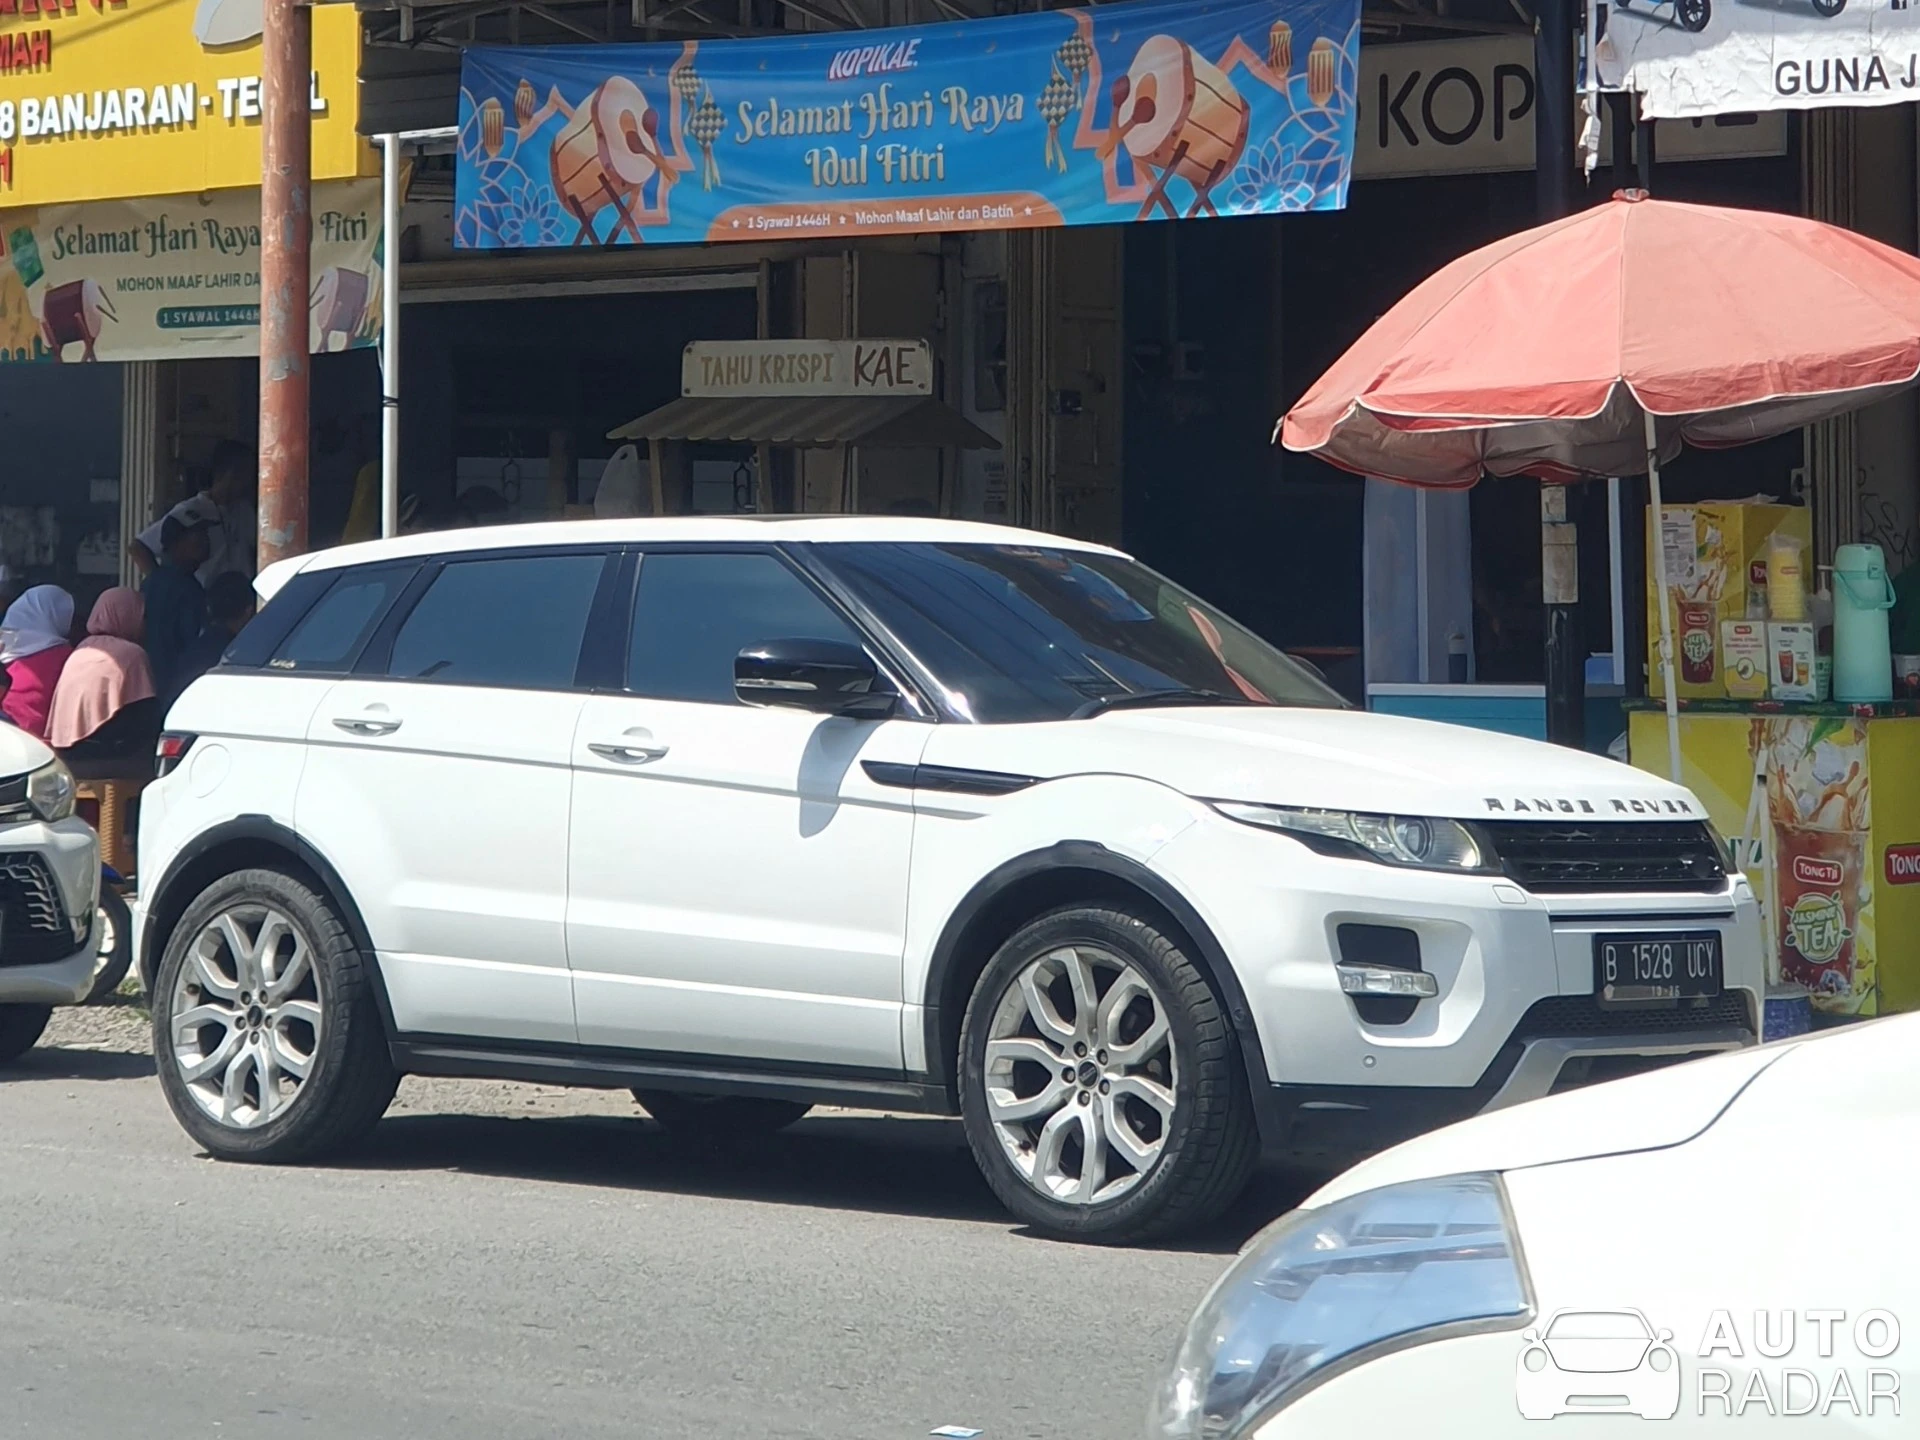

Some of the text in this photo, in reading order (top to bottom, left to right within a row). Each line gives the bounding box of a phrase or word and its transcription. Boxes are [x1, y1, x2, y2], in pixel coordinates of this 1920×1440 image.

[1775, 56, 1891, 96] GUNA
[20, 82, 194, 136] BANJARAN
[218, 70, 325, 118] TEL
[735, 83, 1024, 144] Selamat Hari Raya
[805, 143, 944, 188] Idul Fitri
[747, 213, 830, 231] 1 Syawal 1446H
[855, 204, 1013, 225] Mohon Maaf Lahir dan Batin
[51, 211, 367, 260] Selamat Hari Raya Fitri
[116, 277, 164, 292] MOHON
[167, 275, 202, 290] MAAF
[205, 272, 241, 288] LAHIR
[173, 311, 220, 324] SYAWAL
[701, 344, 916, 388] TAHU KRISPI KAE
[1482, 798, 1692, 813] RANGE ROVER
[1799, 863, 1825, 877] TONG
[1797, 920, 1837, 953] TEA
[1606, 942, 1715, 981] B 1528 UCY
